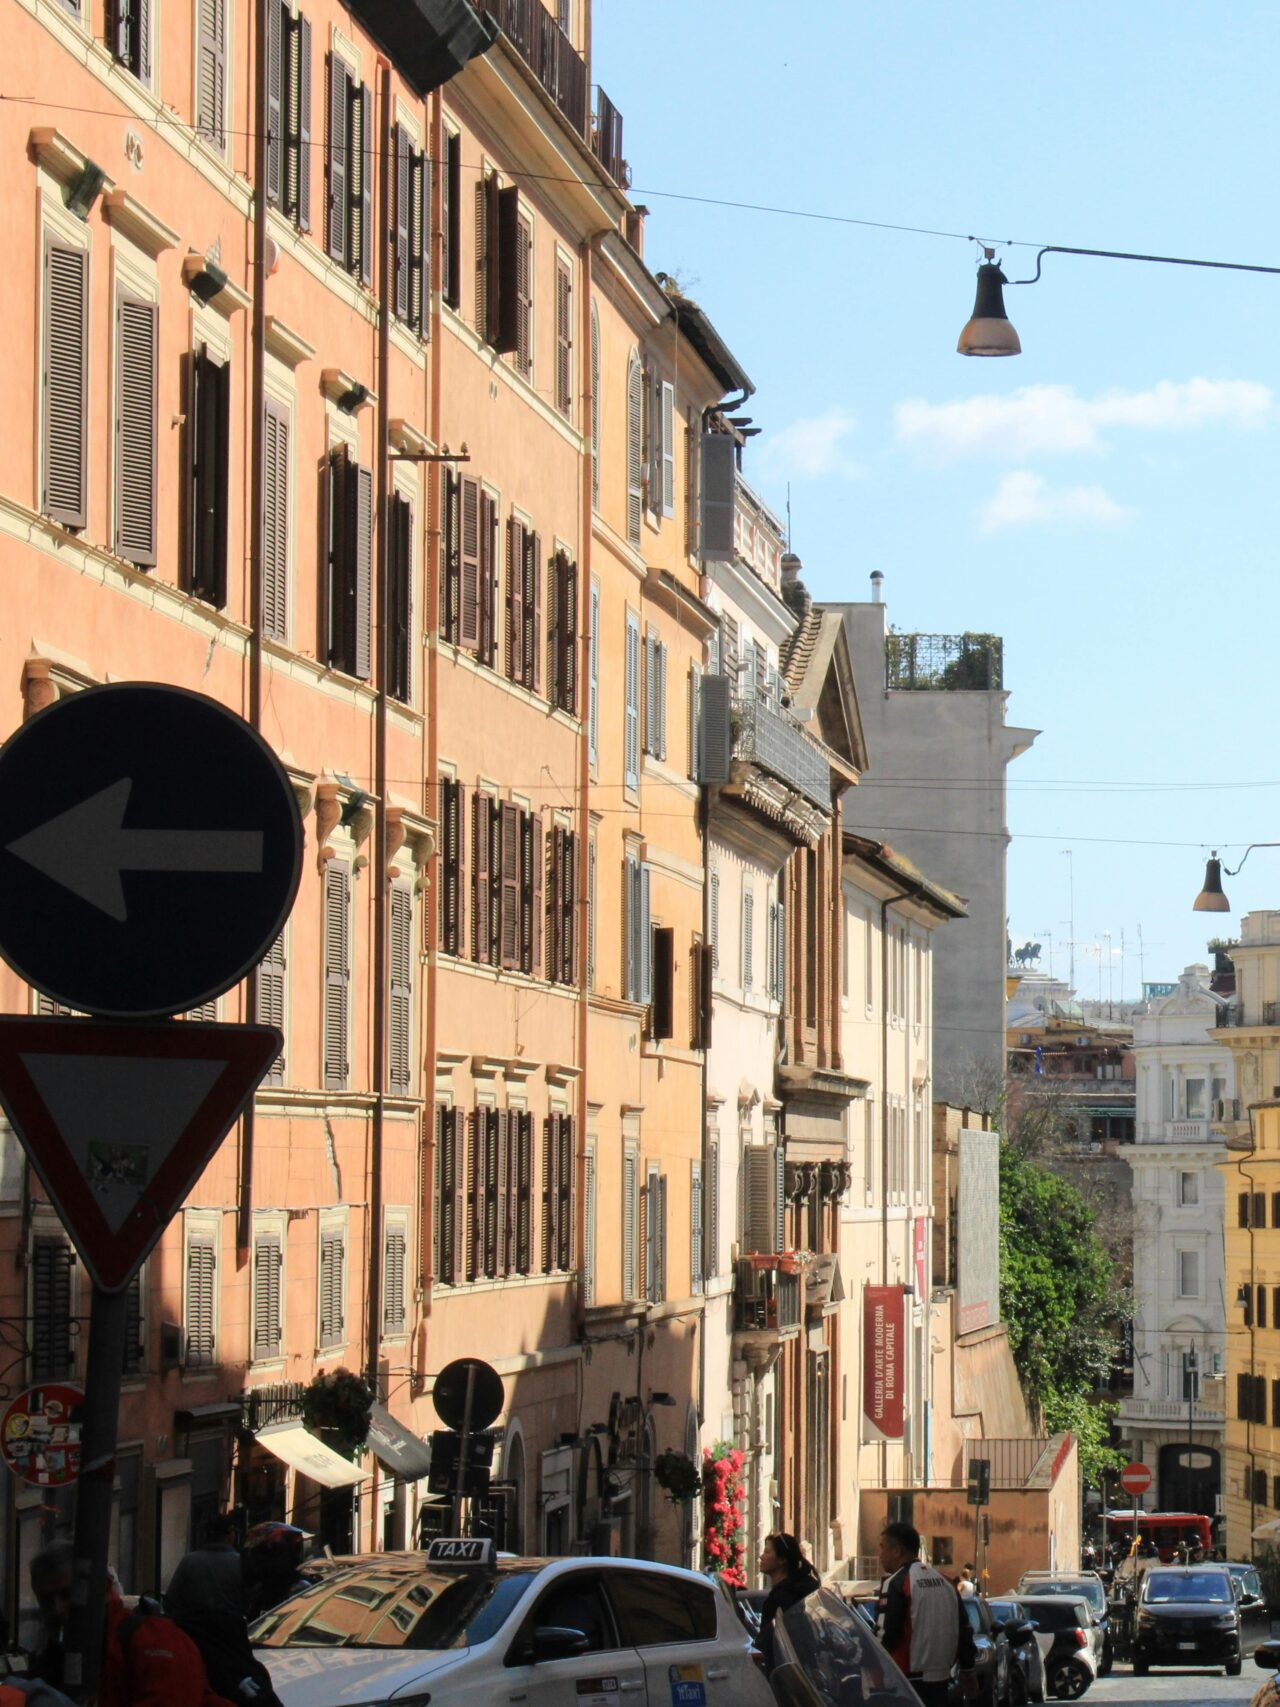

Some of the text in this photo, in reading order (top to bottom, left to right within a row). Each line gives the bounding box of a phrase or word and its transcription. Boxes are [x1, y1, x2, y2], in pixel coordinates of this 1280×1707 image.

[874, 1305, 884, 1346] MODERNA
[874, 1349, 884, 1378] D'ARTE
[885, 1322, 895, 1400] DI ROMA CAPITALE
[874, 1380, 884, 1419] GALLERIA
[437, 1542, 477, 1557] TAXI
[916, 1577, 944, 1587] GERMANY
